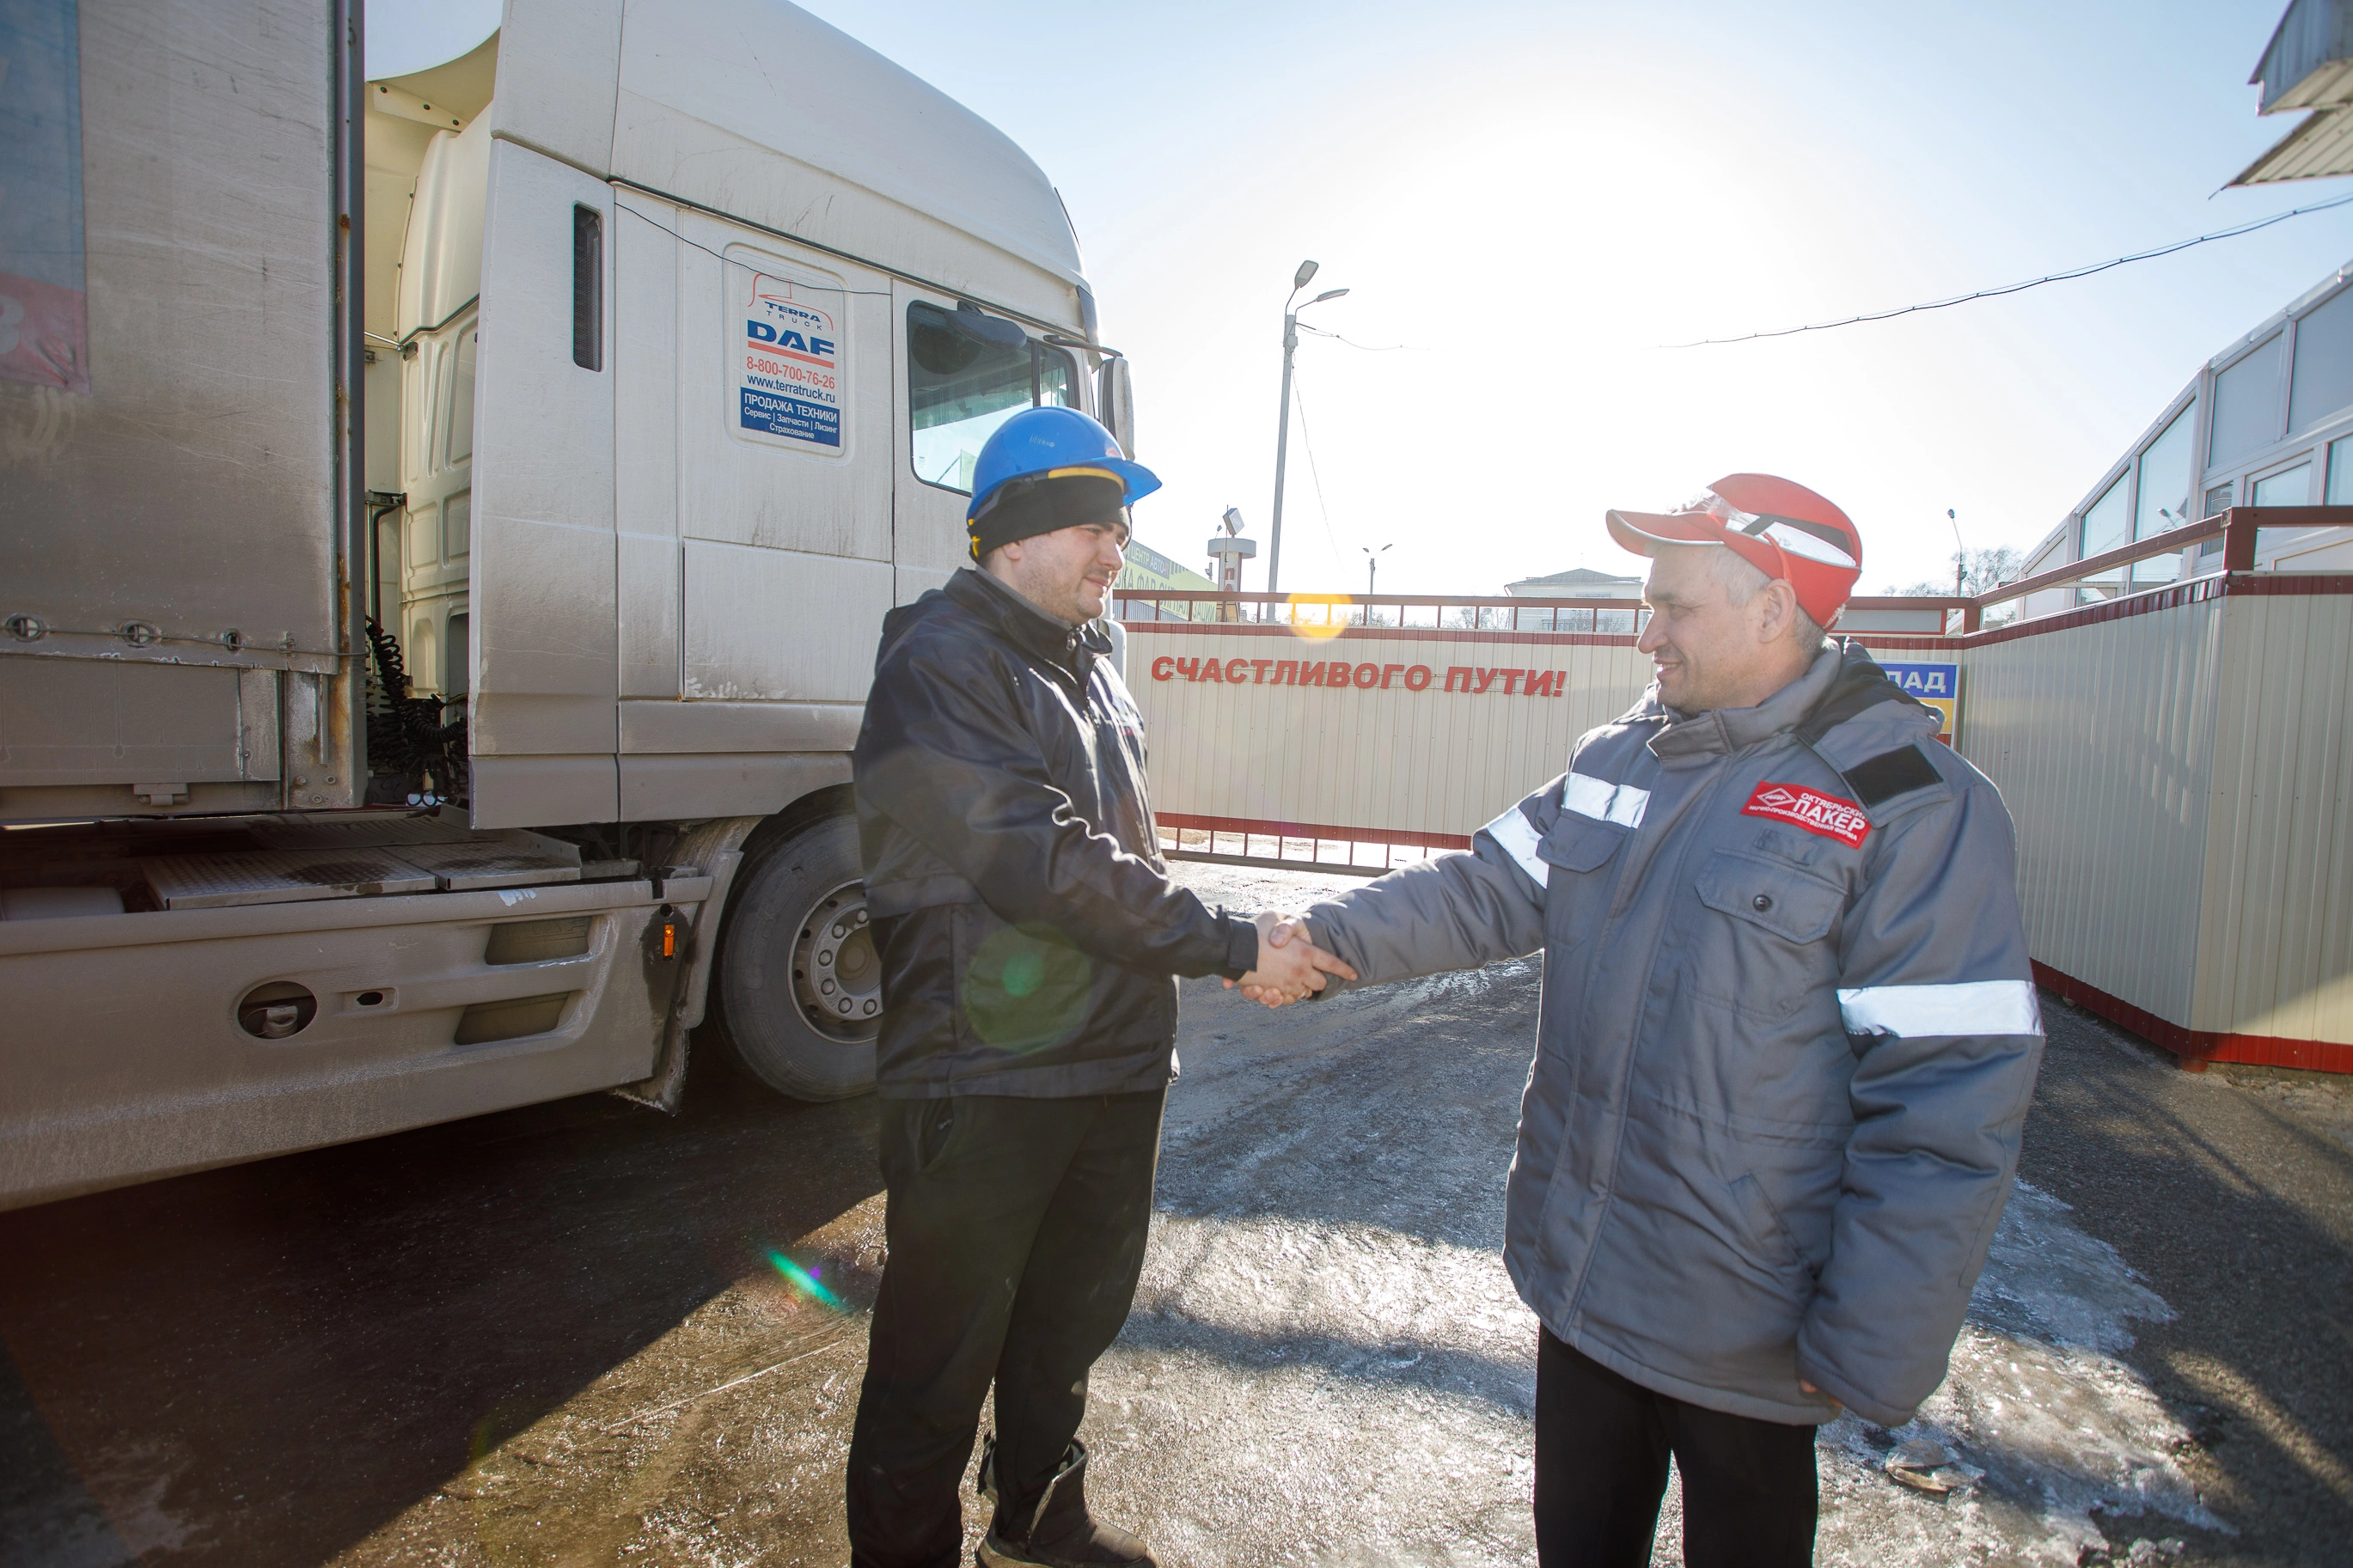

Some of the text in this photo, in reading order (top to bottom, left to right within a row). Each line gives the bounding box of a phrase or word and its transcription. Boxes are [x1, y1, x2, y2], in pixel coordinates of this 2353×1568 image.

[764, 301, 821, 323] TERRA
[766, 310, 822, 331] TRUCK
[747, 319, 834, 356] DAF
[746, 356, 835, 390] 8-800-700-76-26
[747, 375, 835, 404] www.terratruck.ru
[744, 393, 837, 423] ПРОДАЖА ТЕХНИКИ
[744, 406, 838, 434] Сервис Запчасти Лизинг
[769, 422, 815, 439] Страхование
[1151, 656, 1568, 698] СЧАСТЛИВОГО ПУТИ!
[1748, 805, 1858, 841] НАУЧНО-ПРОИЗВОДСТВЕННАЯ ФИРМА
[1792, 798, 1866, 833] ПАКЕР
